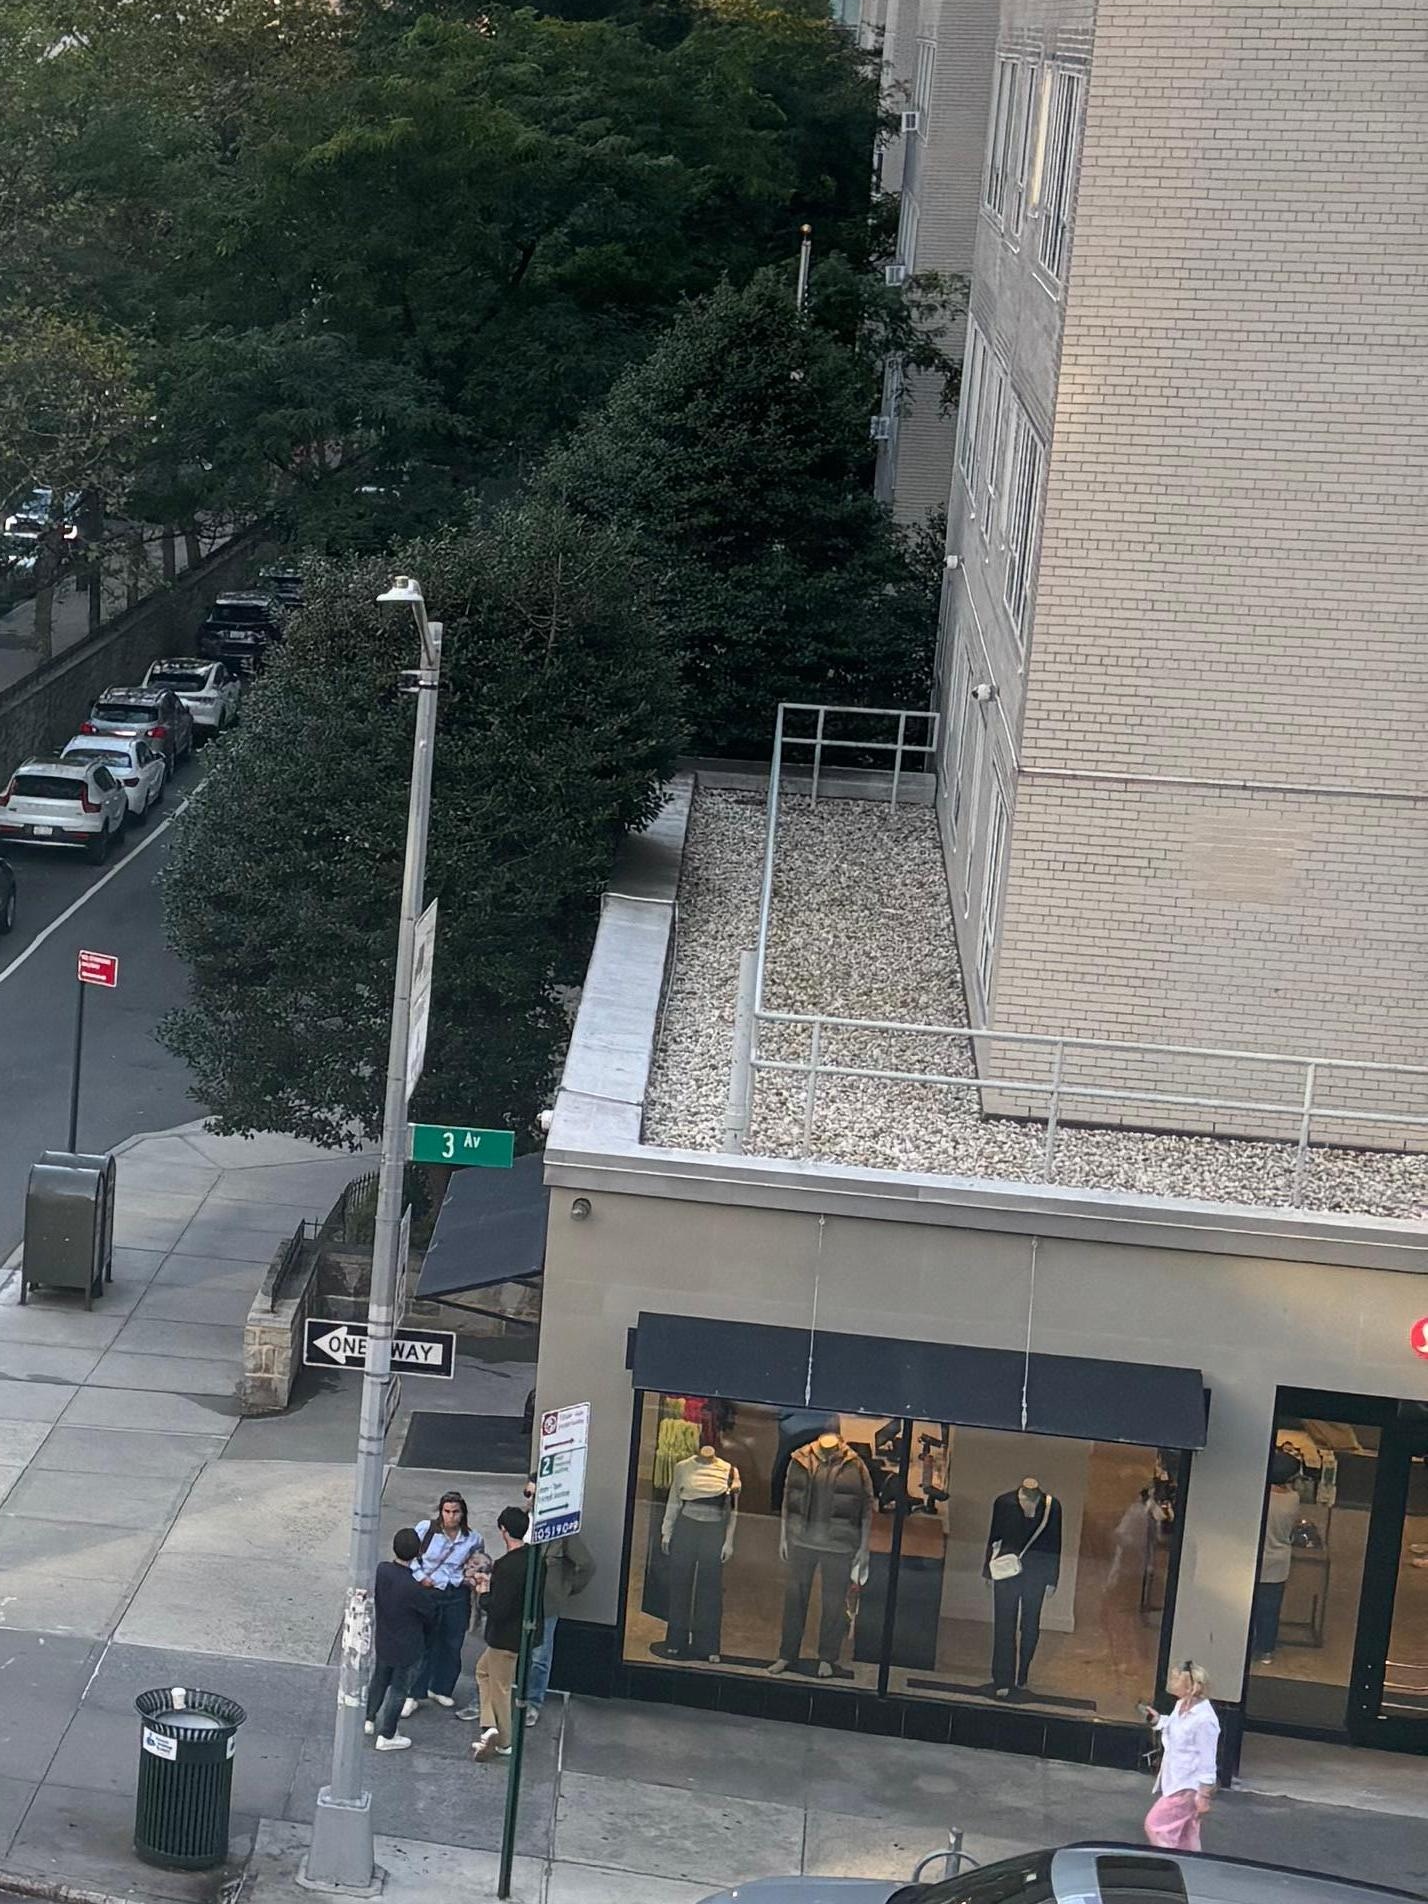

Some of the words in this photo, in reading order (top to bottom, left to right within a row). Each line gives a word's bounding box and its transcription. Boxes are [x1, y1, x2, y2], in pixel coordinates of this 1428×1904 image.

[442, 1132, 455, 1158] 3
[463, 1131, 482, 1149] Av
[328, 1336, 367, 1356] ONE
[391, 1341, 433, 1362] WAY
